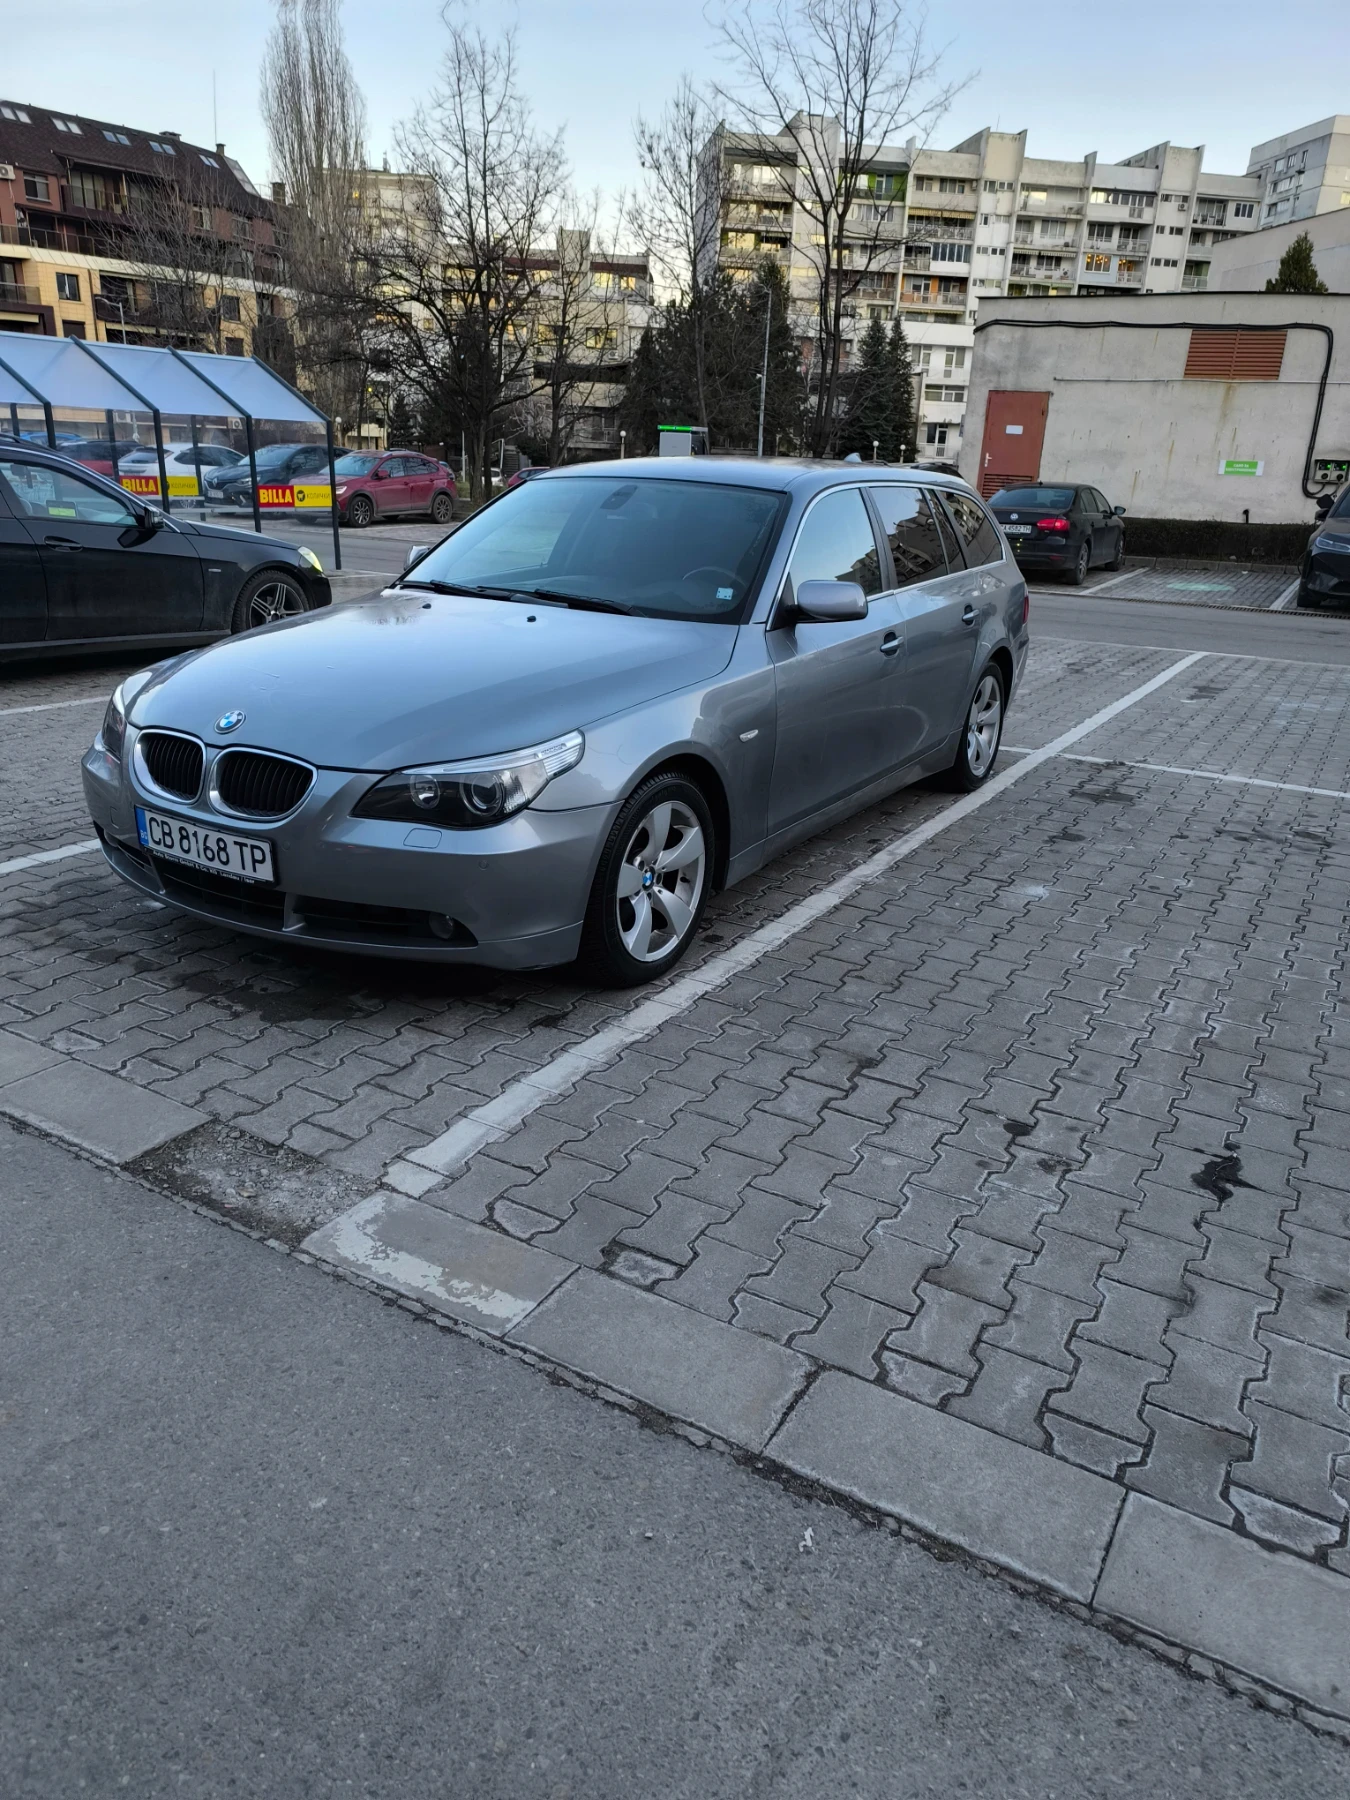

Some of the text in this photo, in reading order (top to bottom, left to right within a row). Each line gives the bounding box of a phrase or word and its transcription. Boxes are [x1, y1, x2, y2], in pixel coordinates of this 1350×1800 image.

[122, 478, 156, 492] BILLA
[259, 488, 293, 504] BILLA
[148, 817, 266, 873] CB 8168 TP
